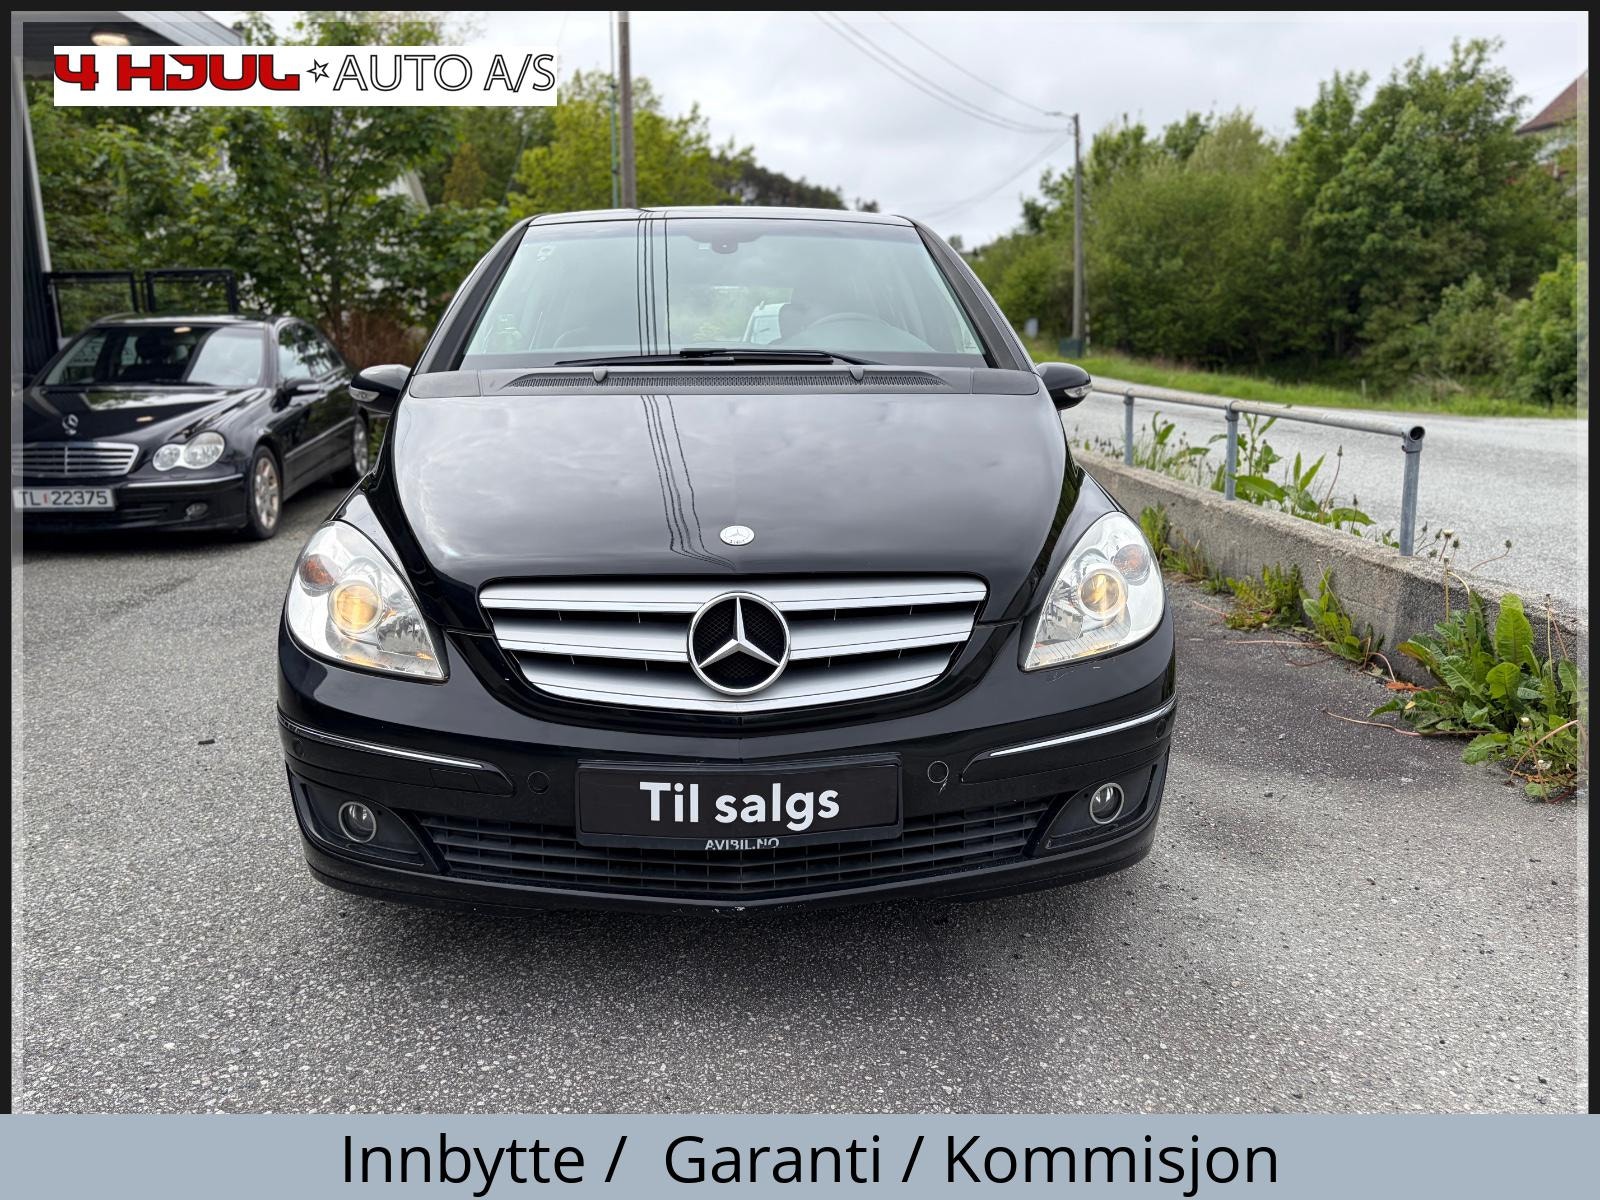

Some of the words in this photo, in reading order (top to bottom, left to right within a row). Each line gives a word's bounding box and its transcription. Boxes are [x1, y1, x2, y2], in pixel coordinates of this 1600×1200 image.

[19, 490, 41, 506] TL
[50, 490, 108, 506] 22375
[639, 781, 699, 823] Til
[714, 782, 840, 832] salgs
